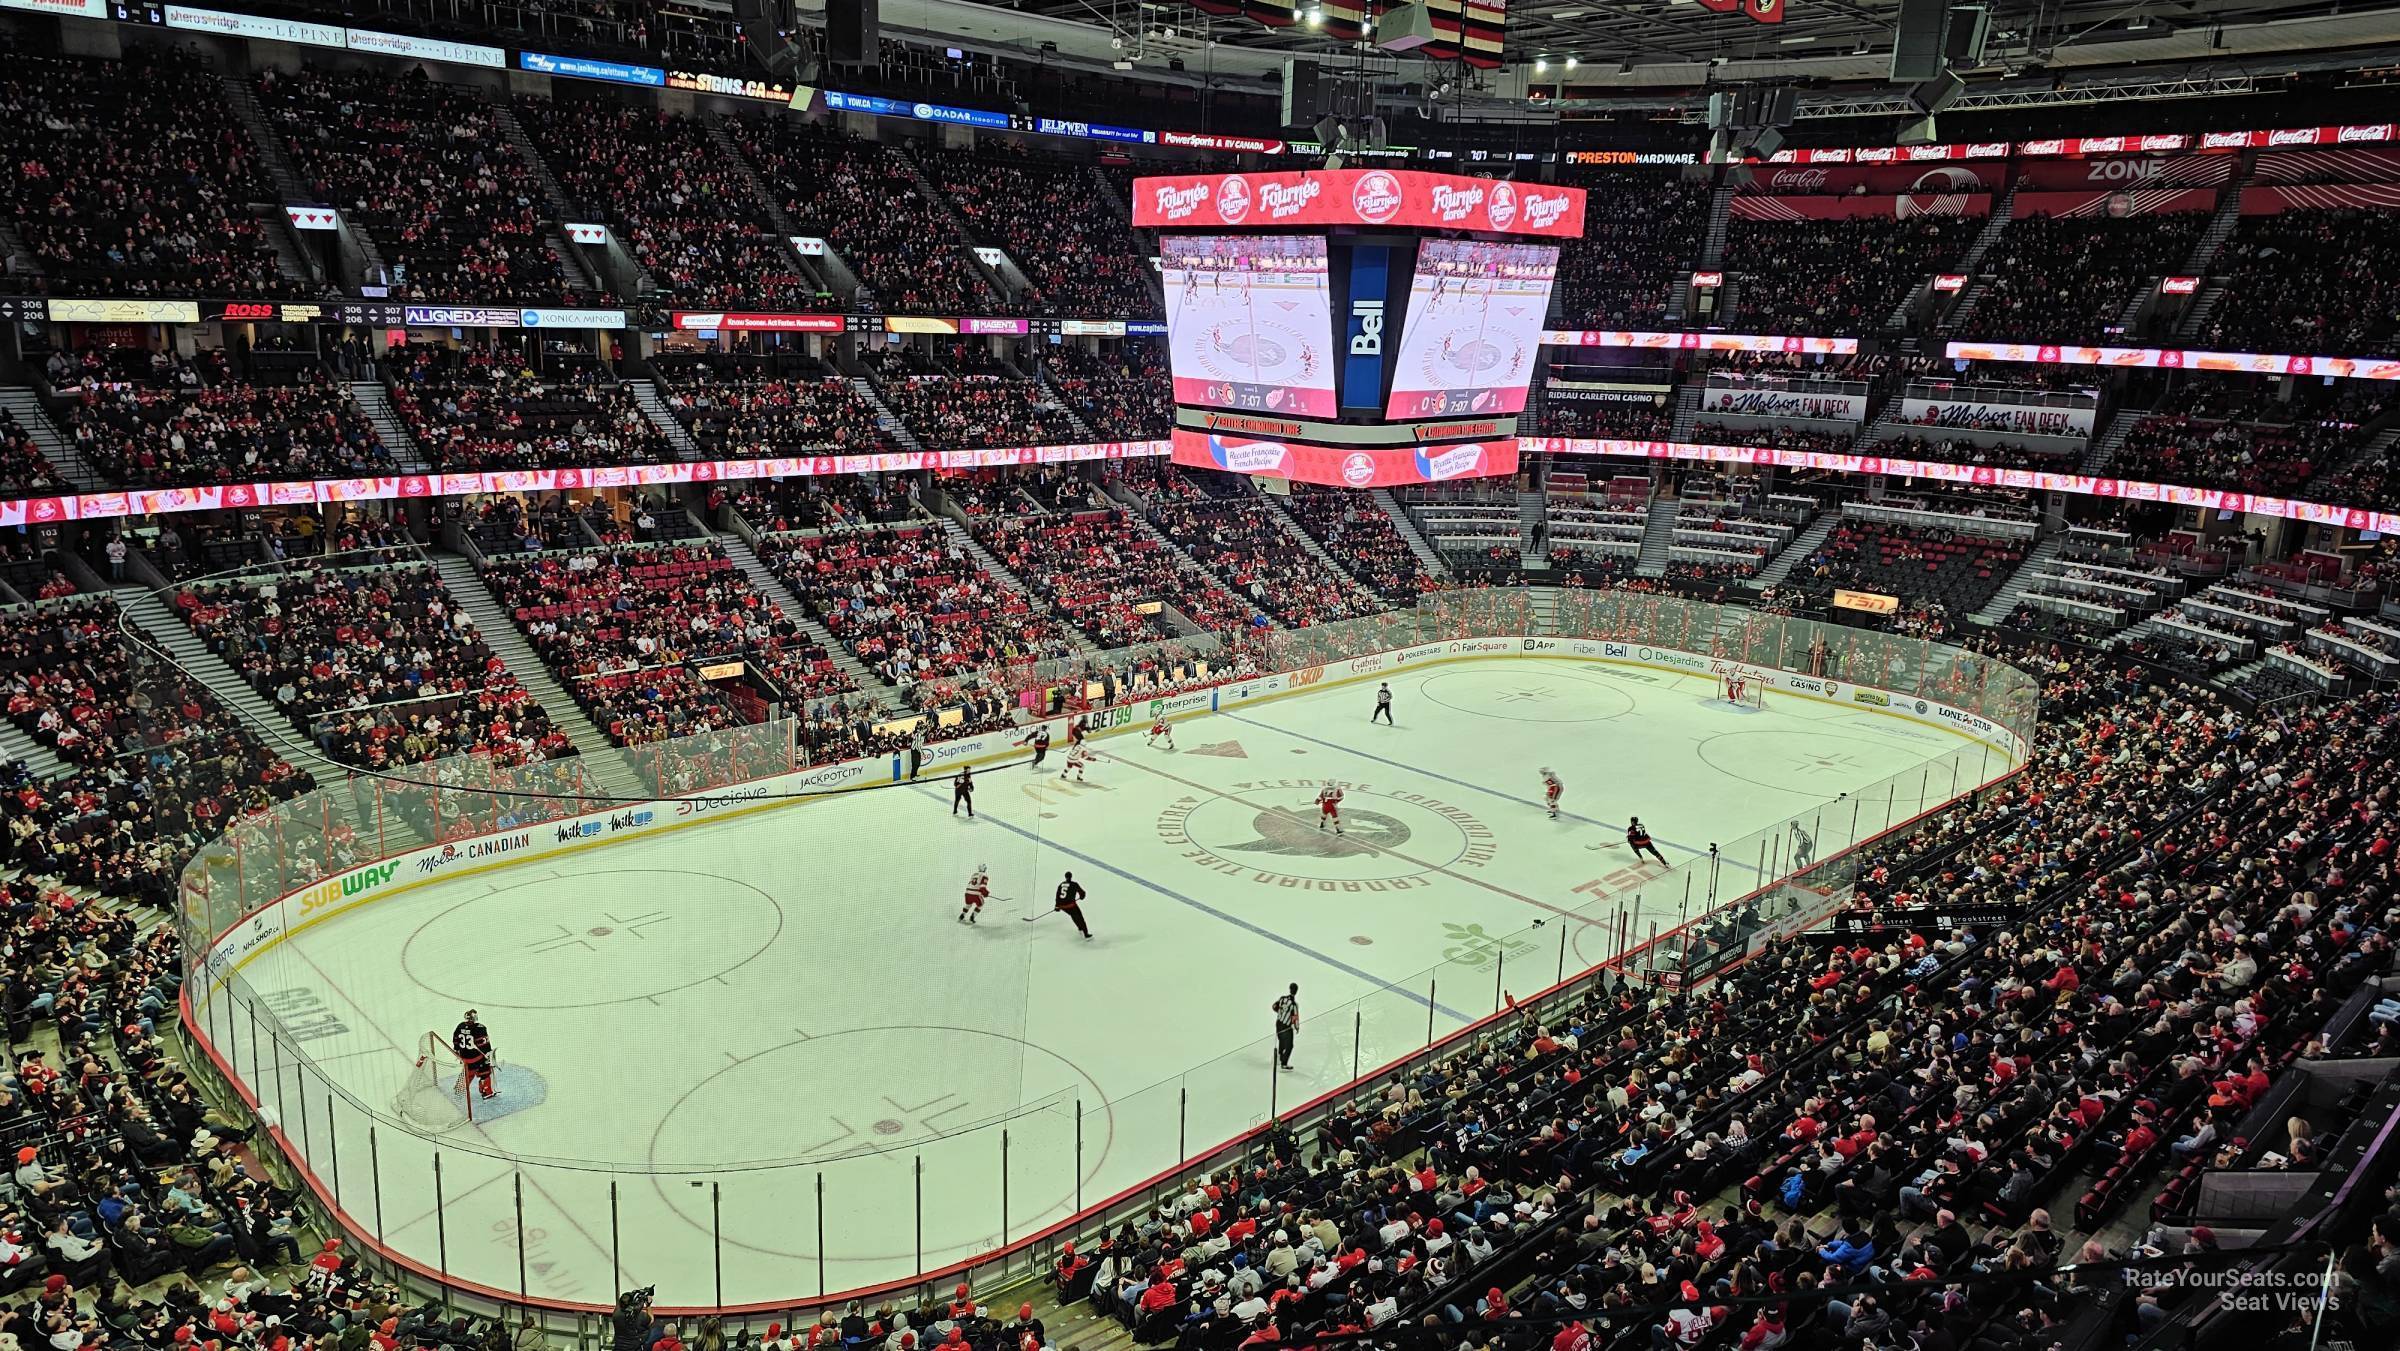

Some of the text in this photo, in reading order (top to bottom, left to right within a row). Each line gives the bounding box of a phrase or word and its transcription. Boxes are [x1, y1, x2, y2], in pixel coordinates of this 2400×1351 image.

[696, 73, 766, 98] SIGNS.CA
[934, 108, 971, 121] GADAR
[1165, 133, 1264, 150] PowerSports & RV CANADA
[2087, 159, 2166, 181] ZONE
[22, 301, 43, 309] 306
[225, 304, 273, 316] ROSS
[344, 306, 362, 314] 306
[23, 312, 45, 320] 206
[386, 316, 402, 324] 207
[407, 310, 474, 323] ALIGNED
[543, 314, 625, 324] KONICA MINOLTA
[980, 320, 1017, 329] MAGENTA
[1350, 300, 1384, 355] Bell
[1208, 386, 1216, 400] 0
[1490, 393, 1496, 407] 1
[1548, 391, 1652, 403] RIDEAU CARLETON CASINO
[1241, 395, 1261, 407] 7:07
[1289, 393, 1296, 408] 1
[1422, 396, 1430, 411] 0
[1450, 400, 1469, 412] 7:07
[1736, 392, 1850, 414] Molson FAN DECK
[1942, 405, 2069, 428] Molson FAN DECK
[1234, 456, 1272, 467] French Recipe
[244, 513, 260, 521] 104
[40, 529, 57, 537] 103
[1845, 594, 1886, 610] TSN
[1405, 647, 1441, 659] POKERSTARS
[1462, 642, 1507, 652] FairSquare
[1573, 643, 1595, 654] Fibe
[1605, 643, 1627, 657] Bell
[1351, 655, 1382, 672] Gabriel
[1655, 651, 1704, 669] Desjardins
[1299, 667, 1324, 687] SKIP
[1791, 679, 1821, 692] CASINO
[1092, 706, 1133, 730] BET99
[1939, 707, 1992, 732] LONE STAR
[937, 741, 982, 759] Supreme
[800, 765, 864, 790] JACKPOTCITY
[695, 786, 768, 813] Decisive
[1389, 790, 1495, 843] CANADIAN
[1461, 842, 1497, 869] TIRE
[417, 834, 530, 873] Molson CANADIAN
[299, 859, 401, 916] SUBWAY
[1060, 886, 1068, 899] 5
[1953, 914, 2007, 924] brookstreet
[242, 925, 280, 953] NHLSHOP.CA
[457, 1034, 475, 1049] 33
